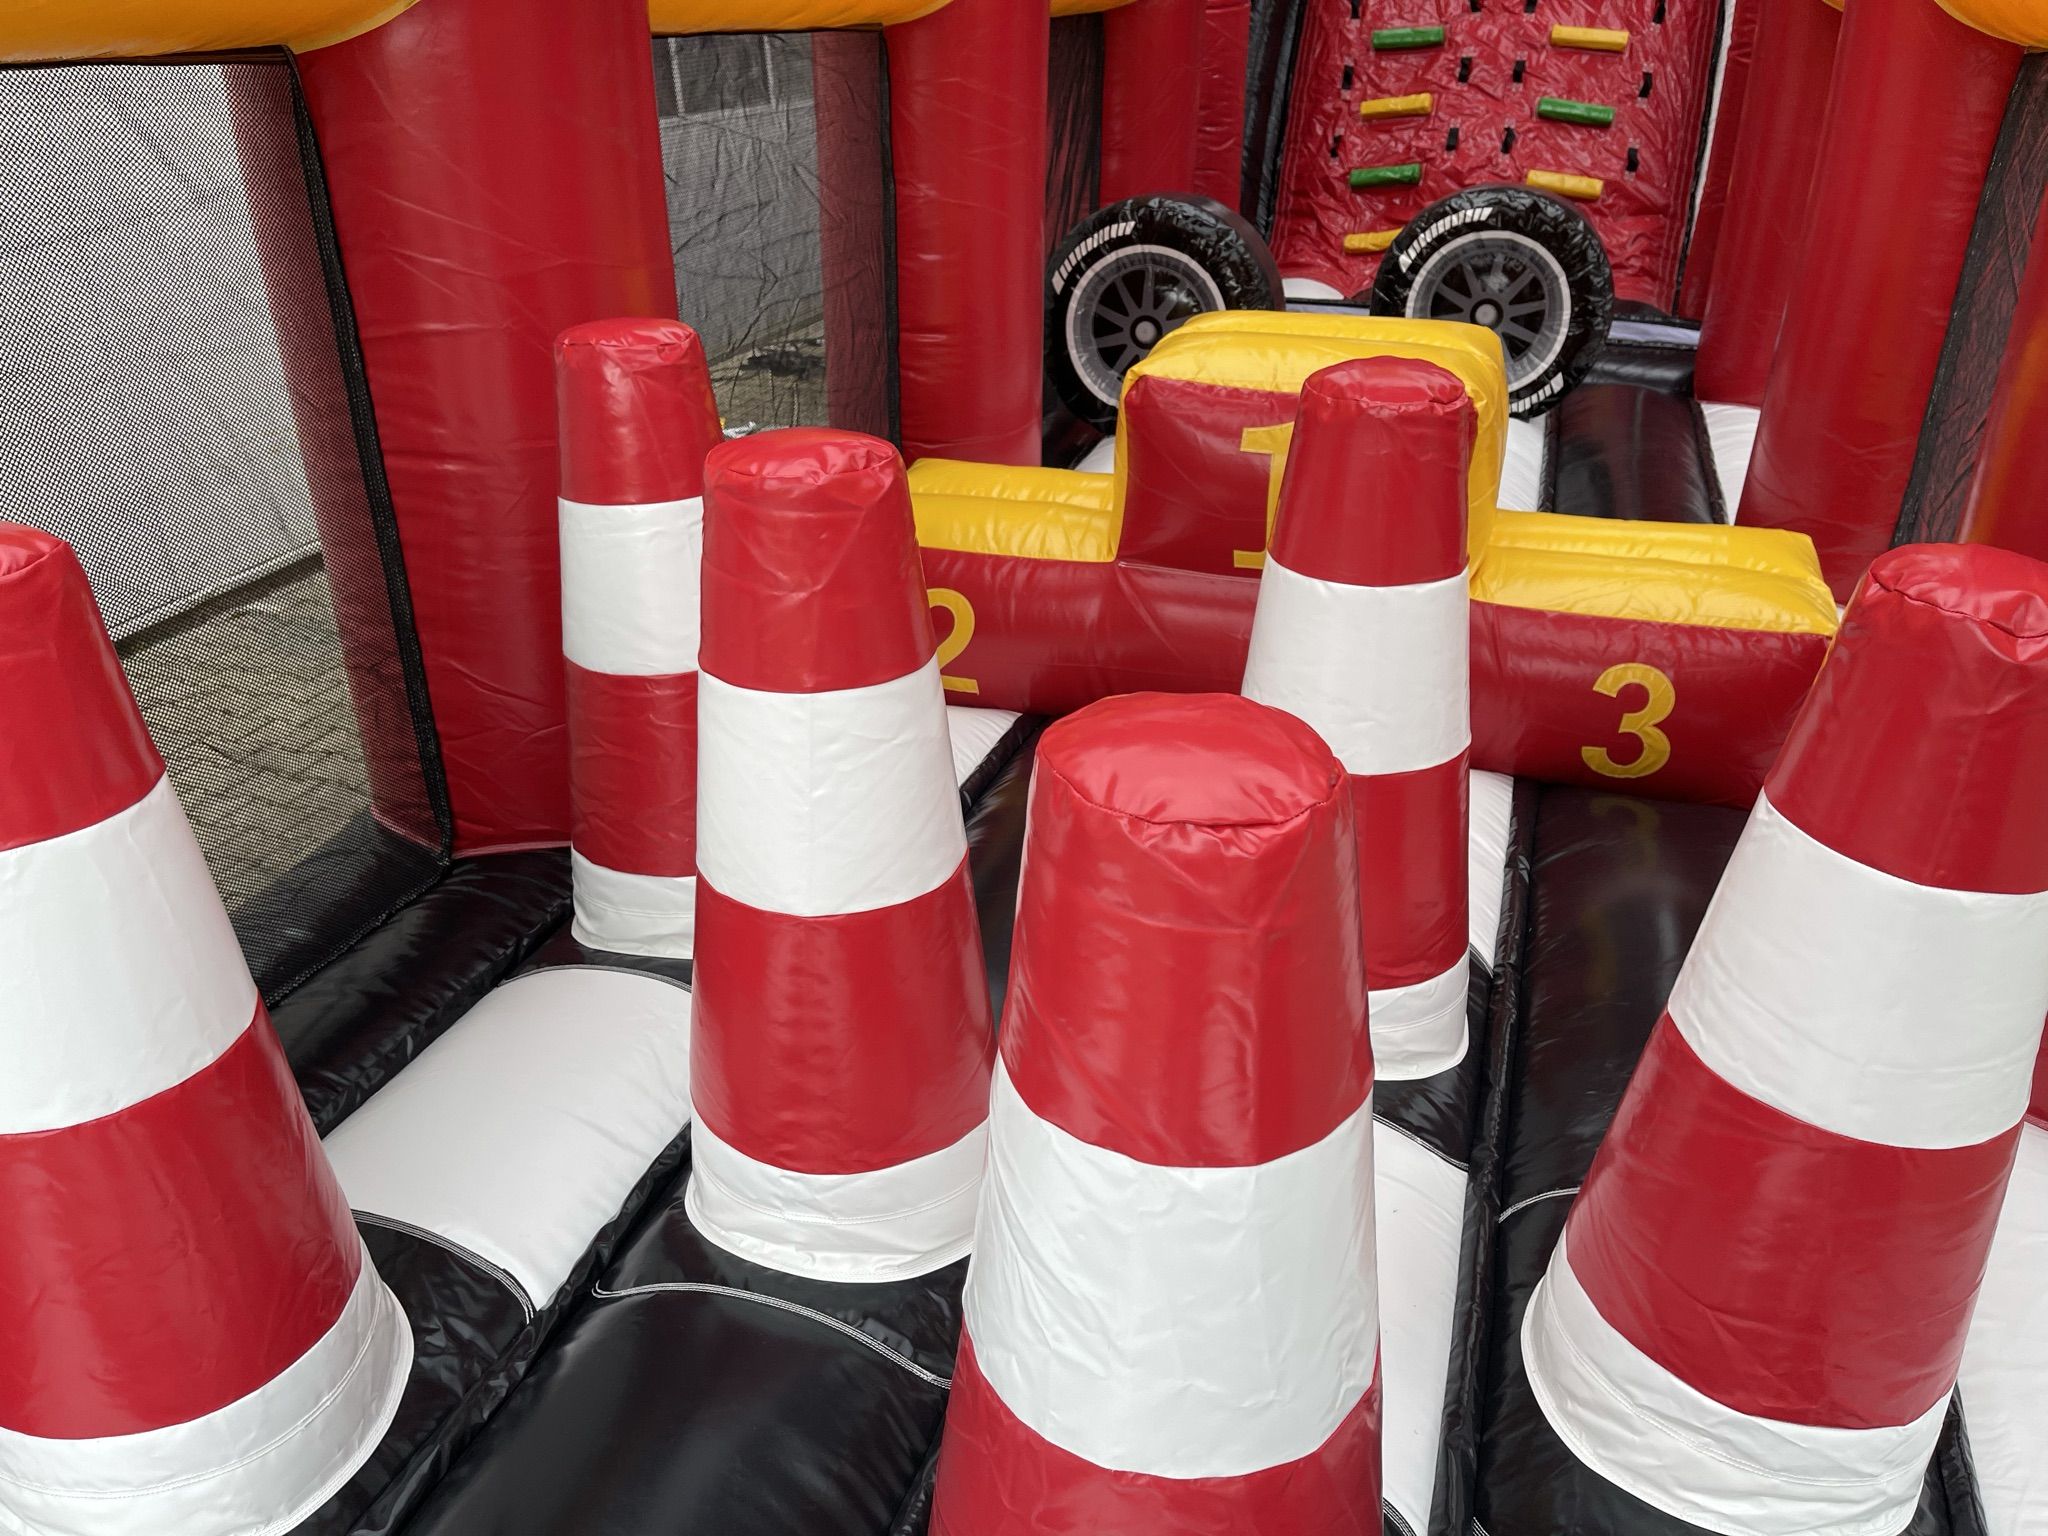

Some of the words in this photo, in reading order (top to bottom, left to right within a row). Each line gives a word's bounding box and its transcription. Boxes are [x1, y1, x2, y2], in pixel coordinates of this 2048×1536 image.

[1233, 421, 1294, 569] 1
[927, 587, 980, 695] 2
[1581, 662, 1676, 778] 3
